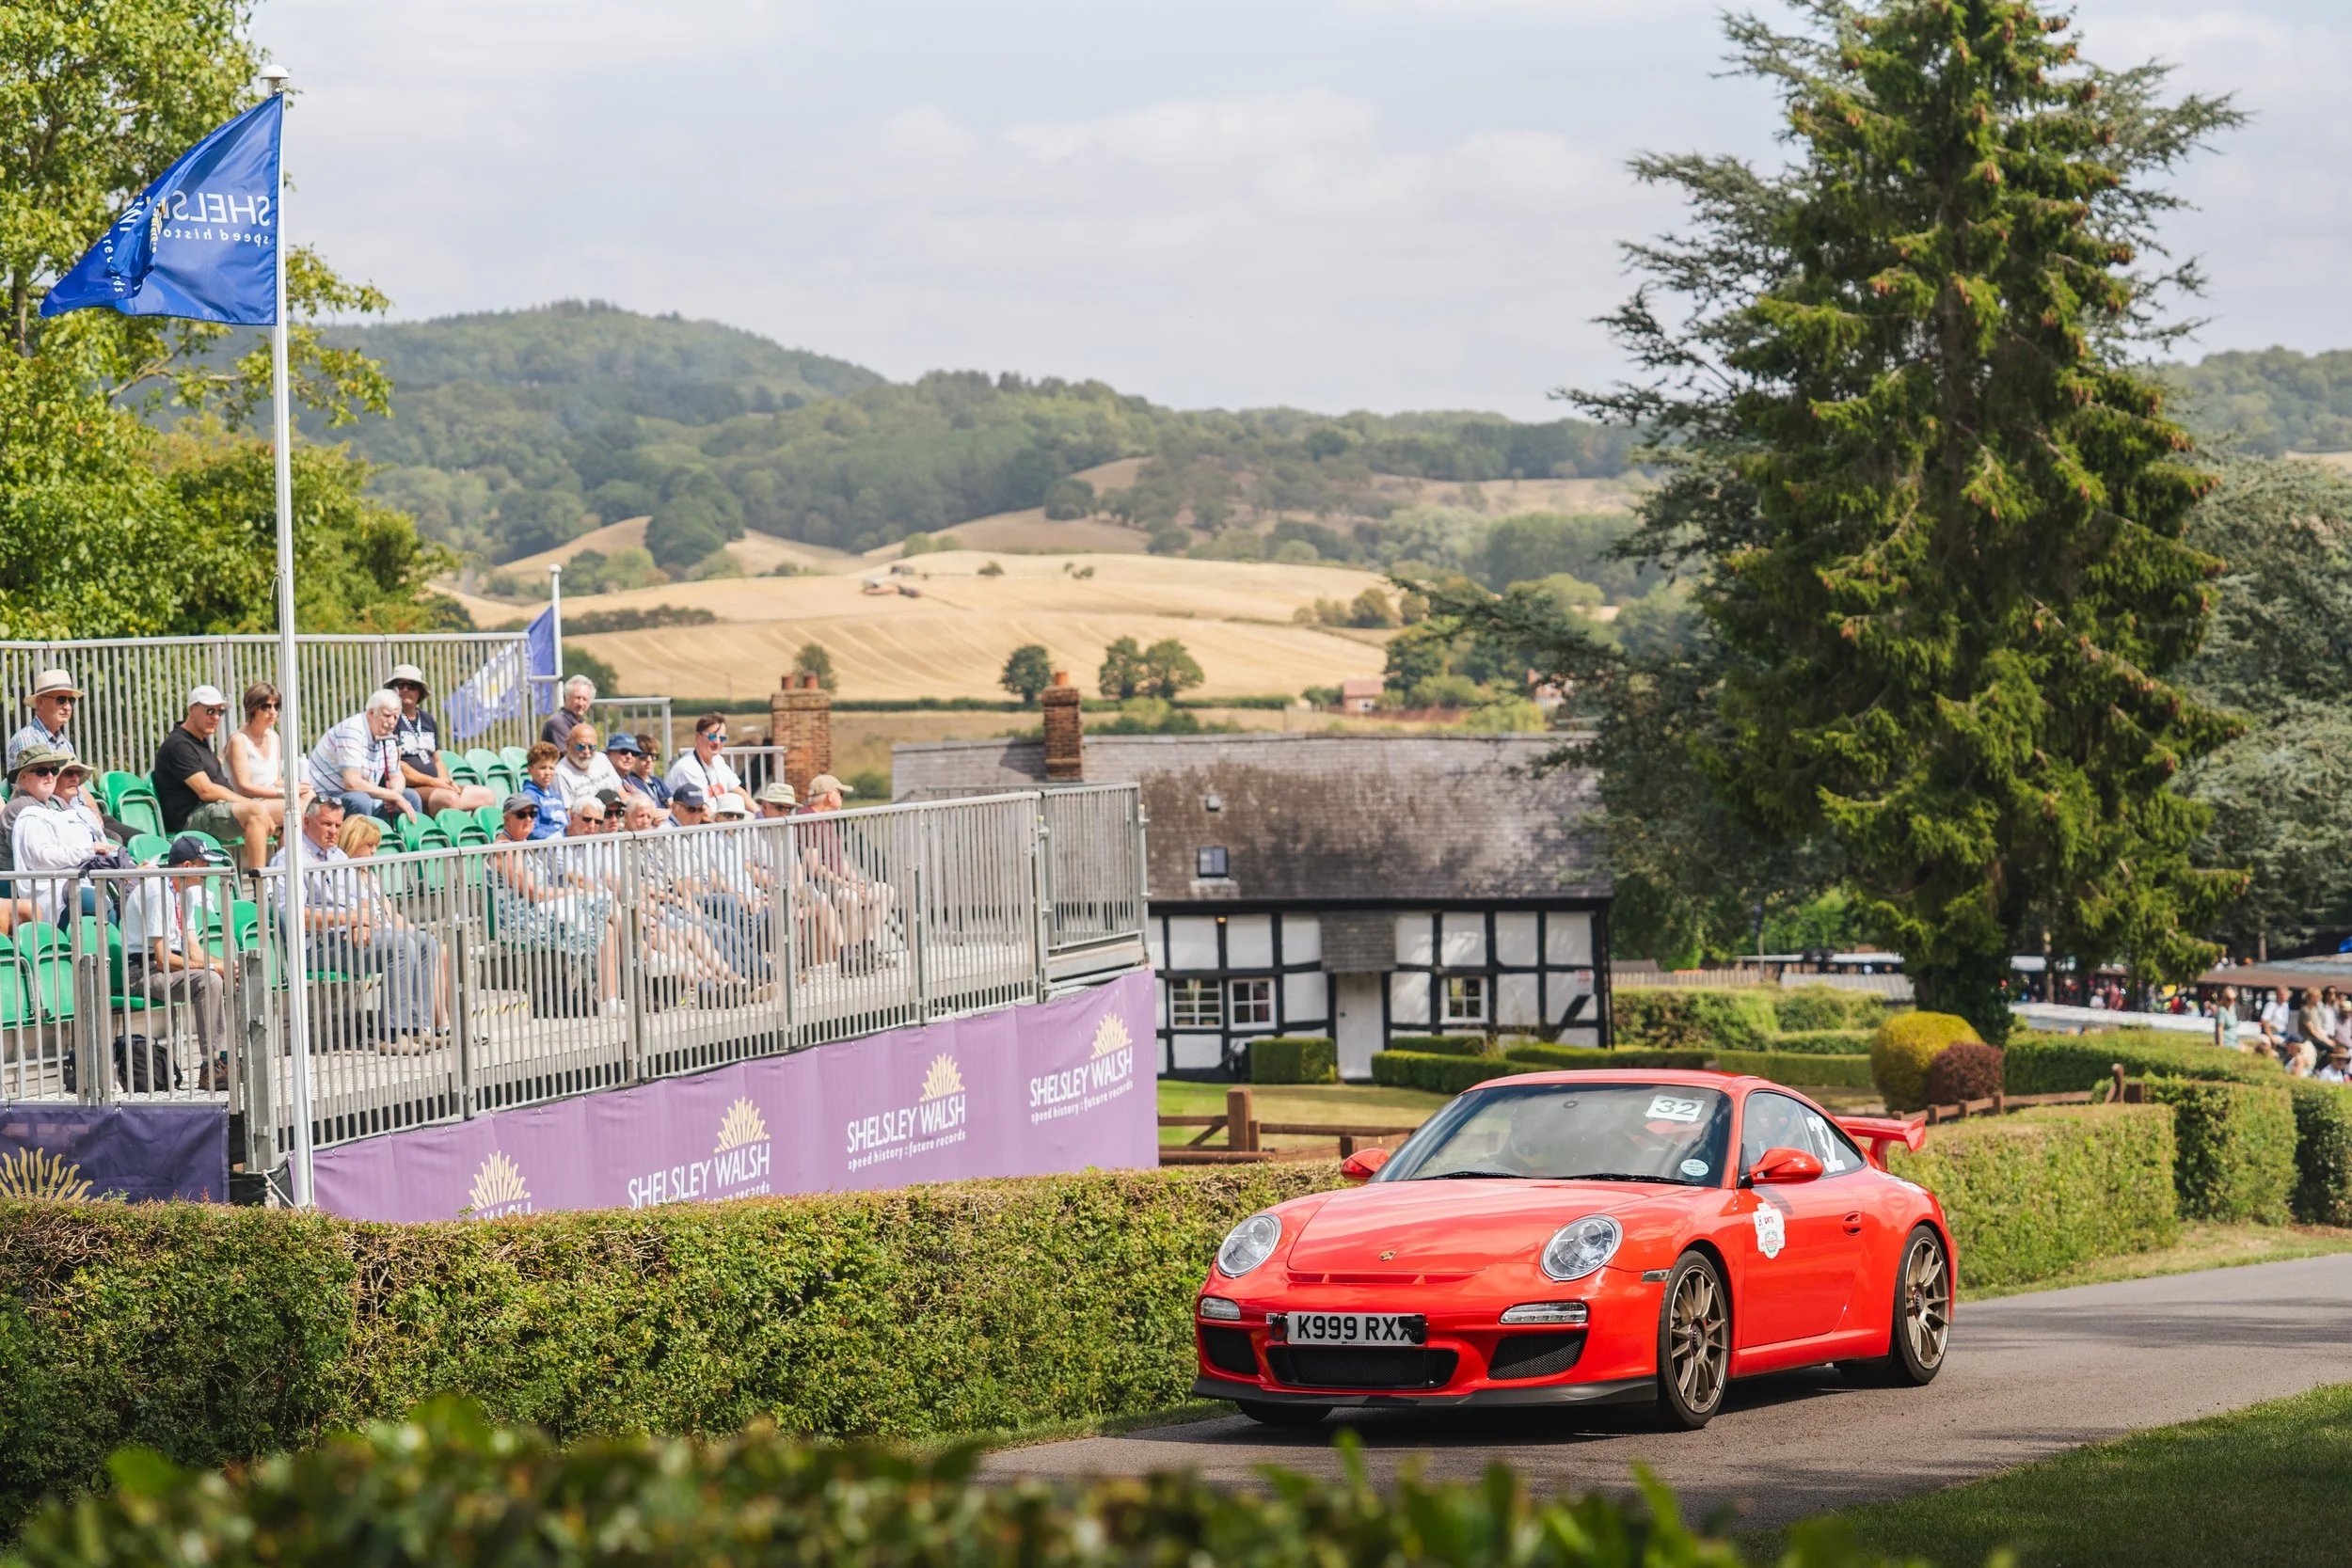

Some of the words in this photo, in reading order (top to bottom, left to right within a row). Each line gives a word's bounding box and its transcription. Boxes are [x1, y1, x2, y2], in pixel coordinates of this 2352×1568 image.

[1030, 1065, 1089, 1108] SHELSLEY
[1090, 1046, 1133, 1089] WALSH
[847, 1106, 918, 1154] SHELSLEY
[919, 1094, 966, 1135] WALSH
[1031, 1106, 1053, 1125] speed
[1083, 1096, 1108, 1112] future
[1656, 1100, 1698, 1117] 32
[848, 1150, 873, 1173] speed
[908, 1141, 935, 1158] future
[935, 1129, 966, 1148] records
[628, 1159, 712, 1212] SHELSLEY
[714, 1142, 771, 1190] WALSH
[1297, 1315, 1358, 1340] K999
